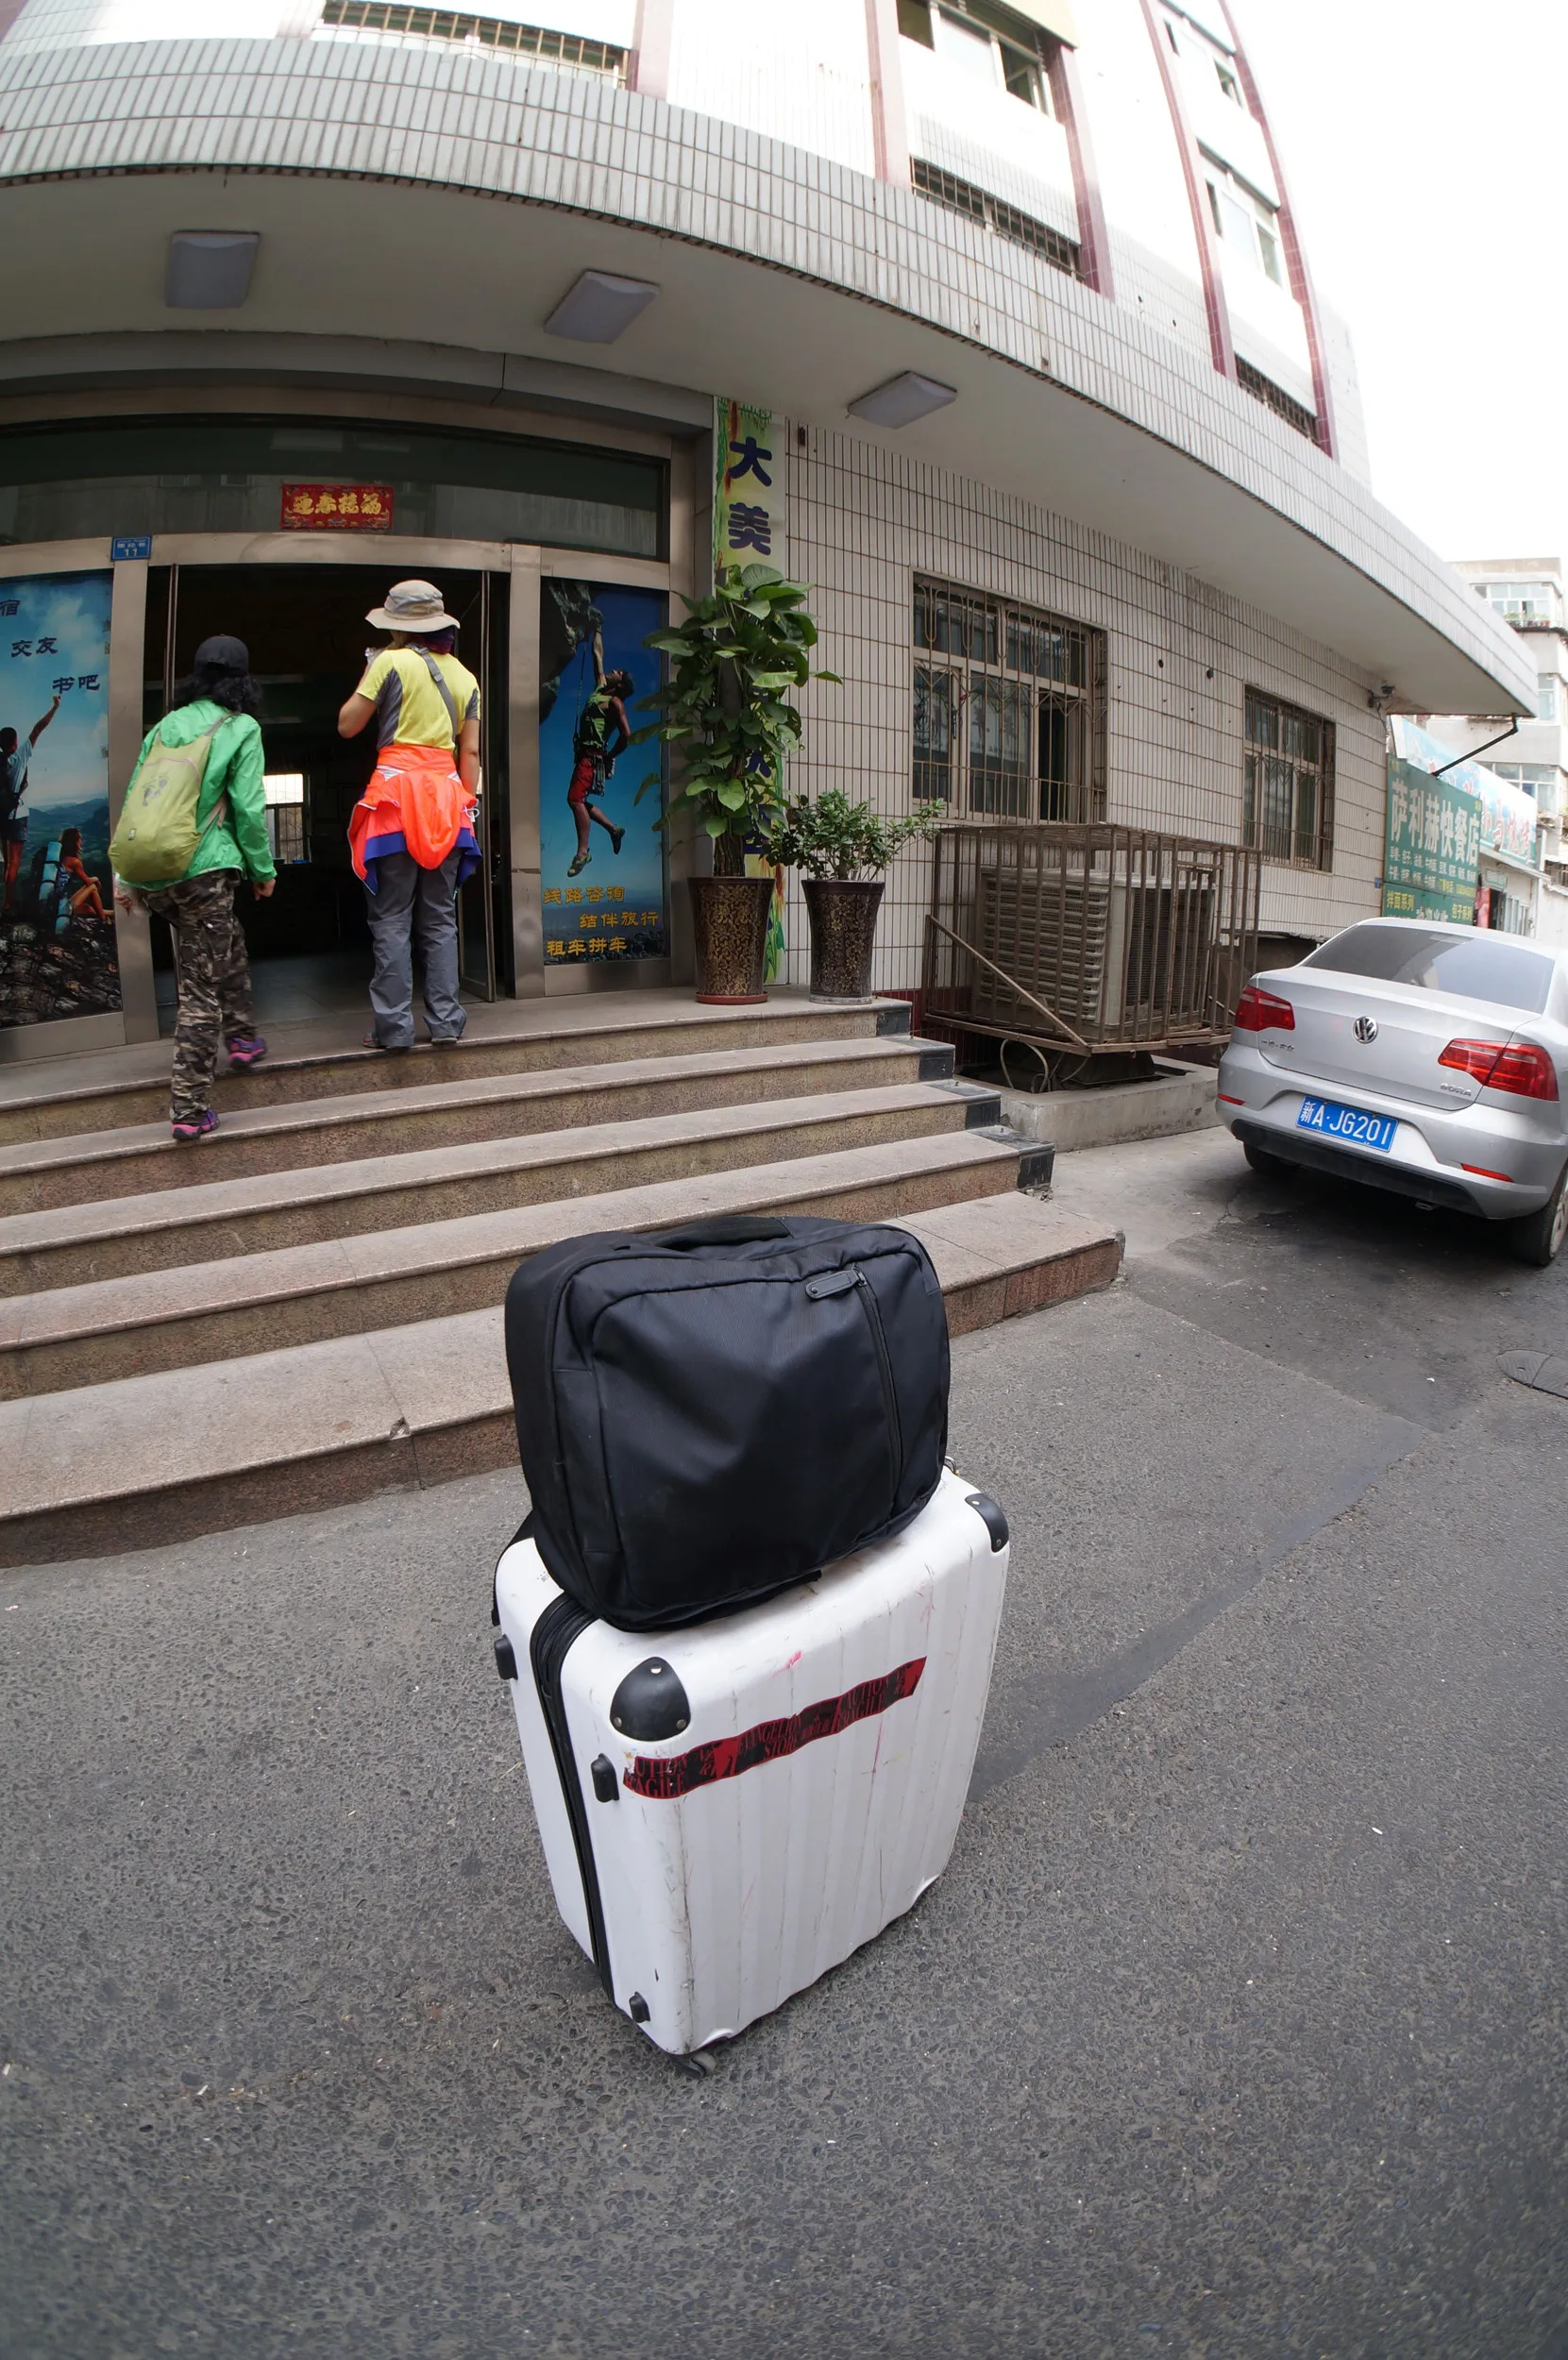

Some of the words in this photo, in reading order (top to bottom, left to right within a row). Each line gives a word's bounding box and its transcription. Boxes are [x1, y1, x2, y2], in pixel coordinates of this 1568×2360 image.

[125, 548, 138, 557] 11
[10, 636, 59, 658] 交友
[52, 674, 100, 695] 书吧
[1390, 777, 1480, 868] 萨利赫快餐店
[543, 885, 626, 904] 线路咨询
[579, 910, 659, 928] 结伴旅行
[546, 936, 628, 956] 租车拼车
